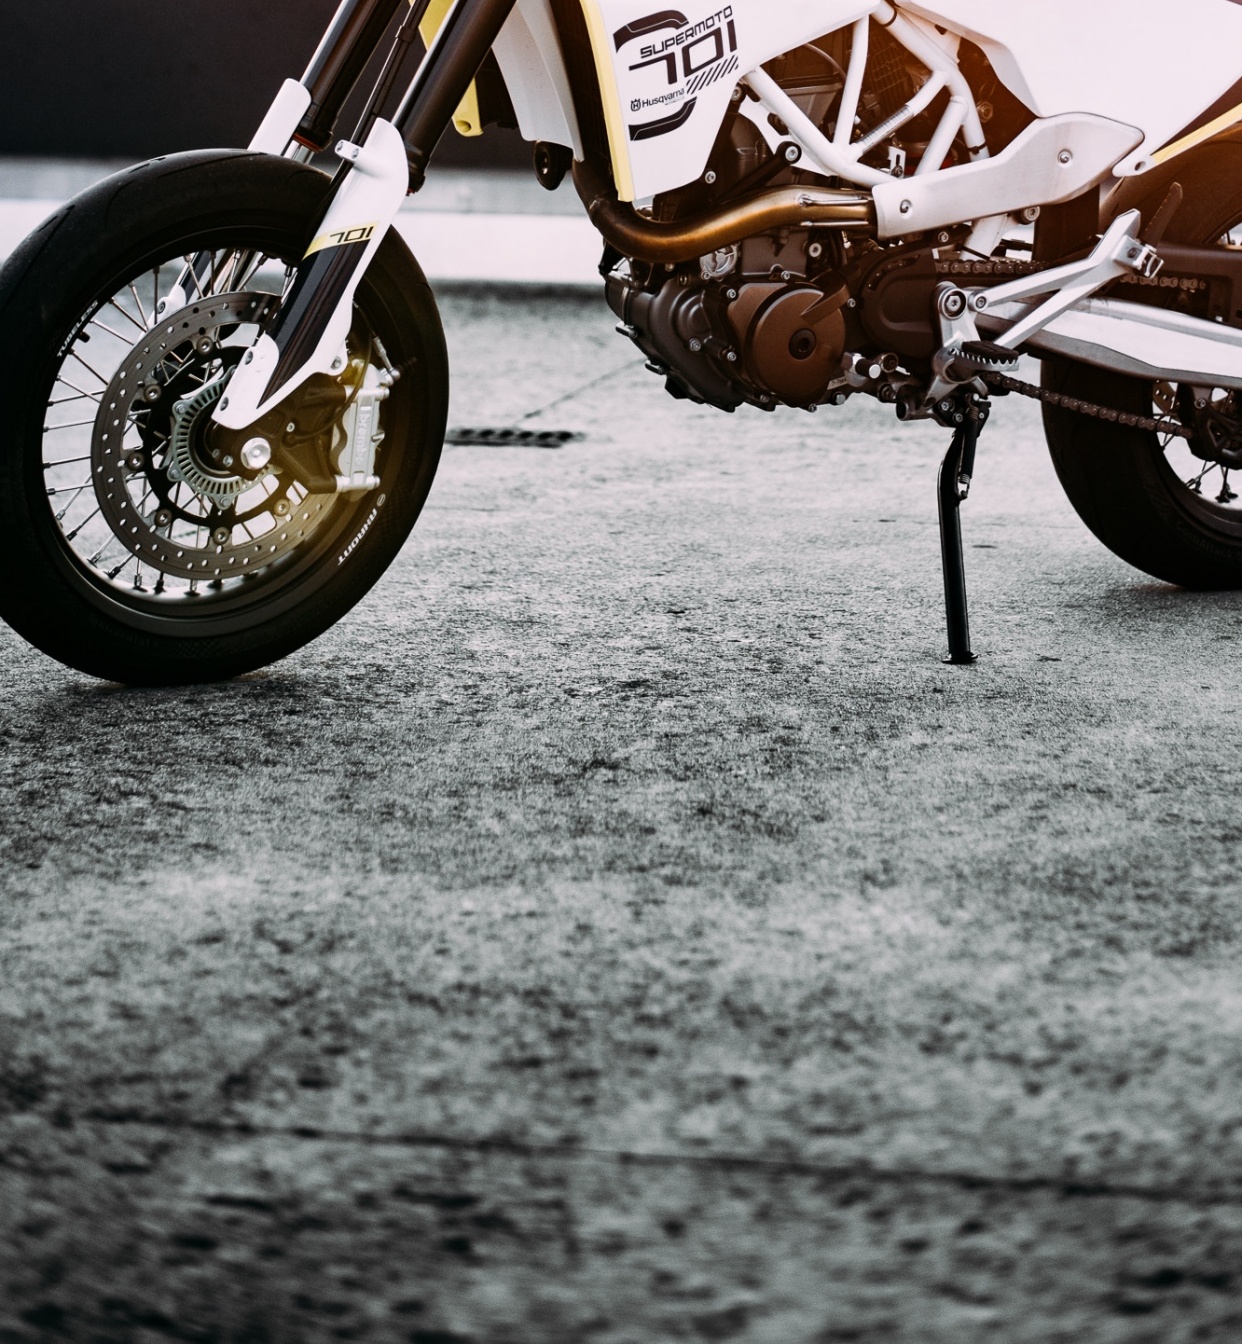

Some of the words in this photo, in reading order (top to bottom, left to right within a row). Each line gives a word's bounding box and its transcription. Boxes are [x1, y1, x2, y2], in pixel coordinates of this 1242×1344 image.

[628, 19, 738, 85] 701
[640, 5, 733, 59] SUPERMOTO
[641, 88, 685, 108] Husqvarna
[329, 226, 374, 244] 701
[57, 300, 98, 357] TUBELESS
